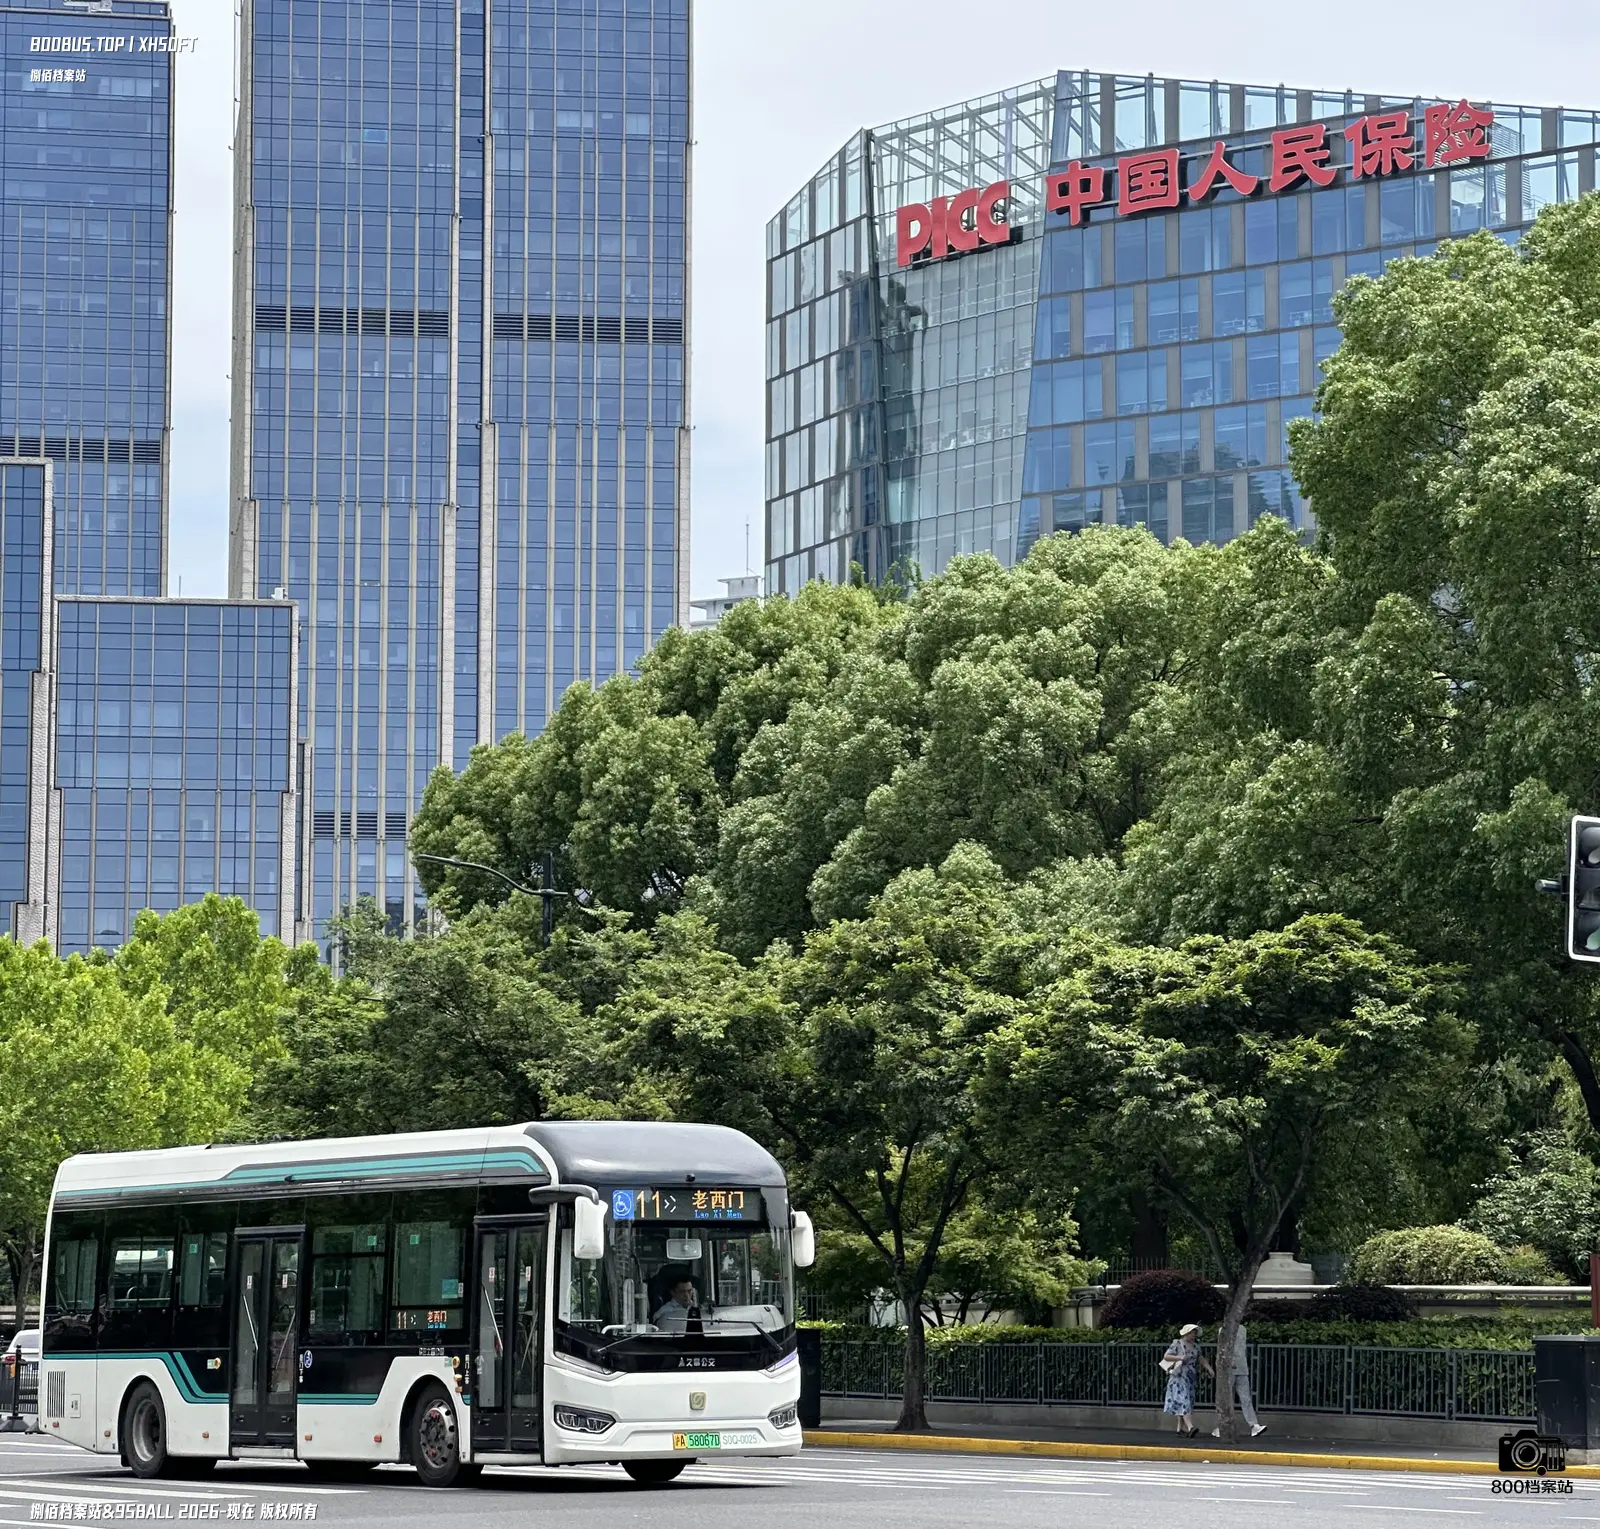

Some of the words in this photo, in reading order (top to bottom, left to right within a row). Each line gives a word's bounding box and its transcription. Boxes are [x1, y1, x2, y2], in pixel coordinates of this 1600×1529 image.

[897, 180, 1010, 267] PICC
[1046, 98, 1495, 226] 中国人民保险
[636, 1190, 660, 1218] 11
[691, 1190, 745, 1210] 老西门
[694, 1210, 710, 1219] Lao
[713, 1210, 723, 1219] Xi
[726, 1210, 743, 1219] Men
